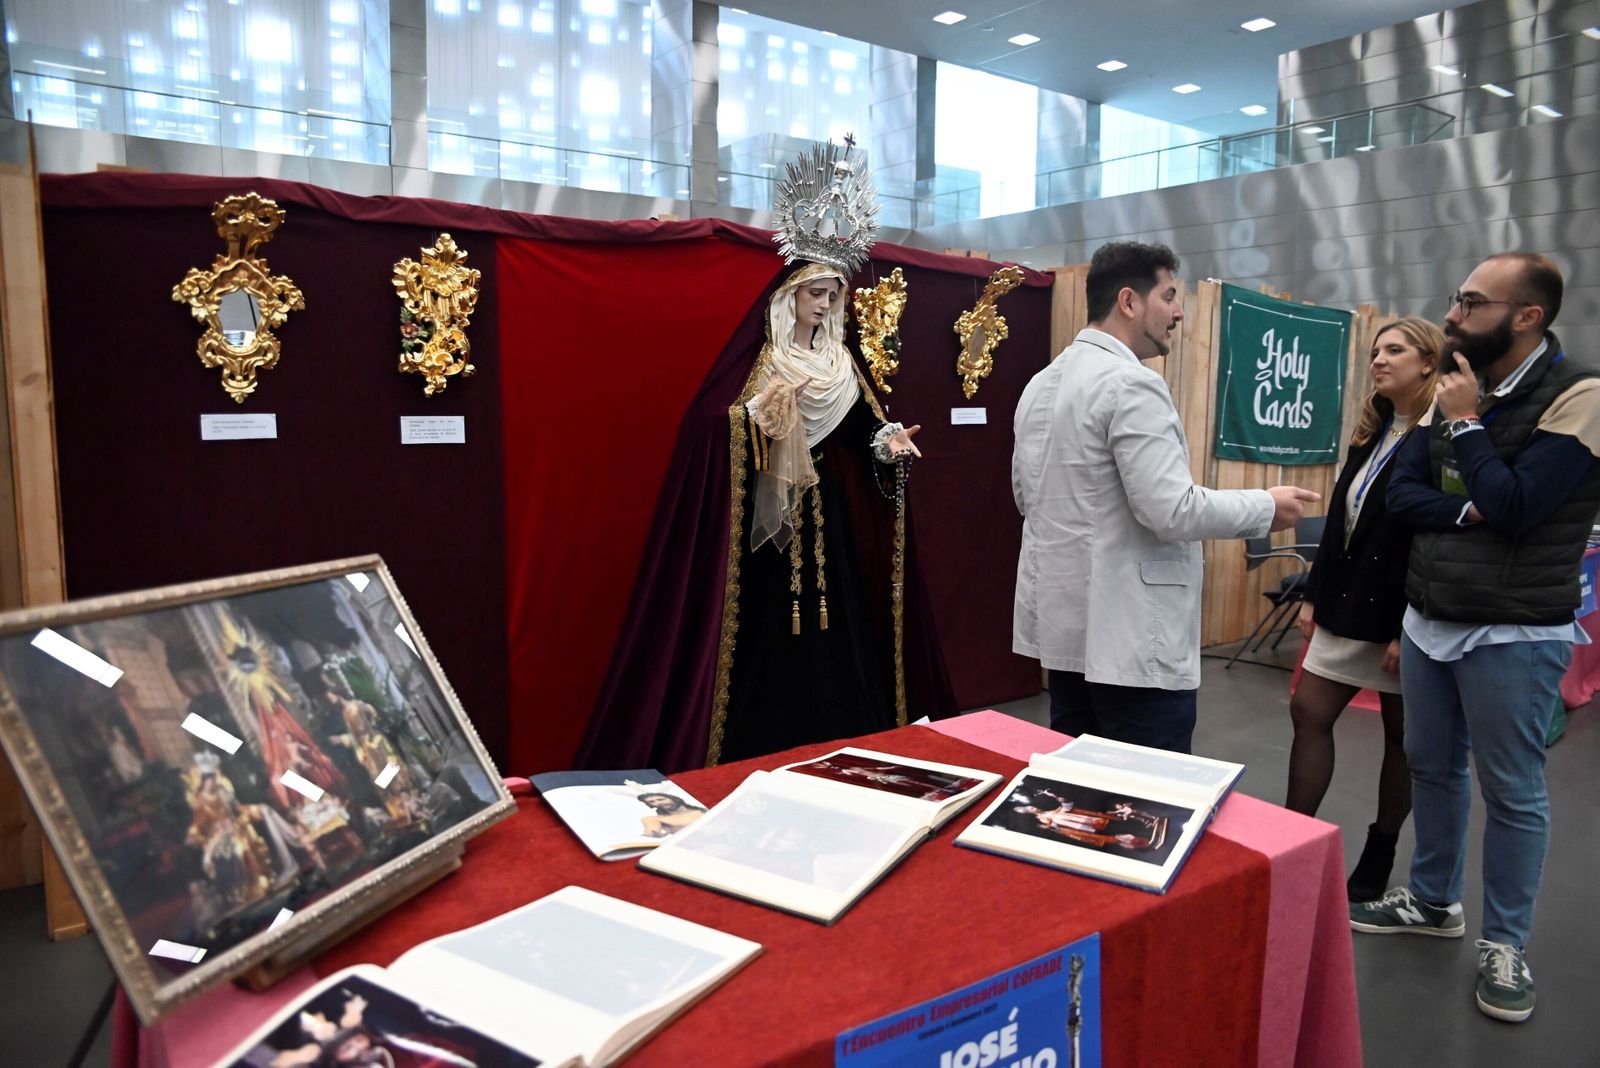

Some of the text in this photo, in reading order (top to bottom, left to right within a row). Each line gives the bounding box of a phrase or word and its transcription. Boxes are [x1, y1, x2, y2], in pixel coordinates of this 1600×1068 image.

[1256, 327, 1311, 391] Holy
[1253, 379, 1314, 429] Cards
[851, 1013, 925, 1053] Encuentro
[931, 976, 1009, 1023] Empresarial
[1013, 956, 1062, 991] COFRADE
